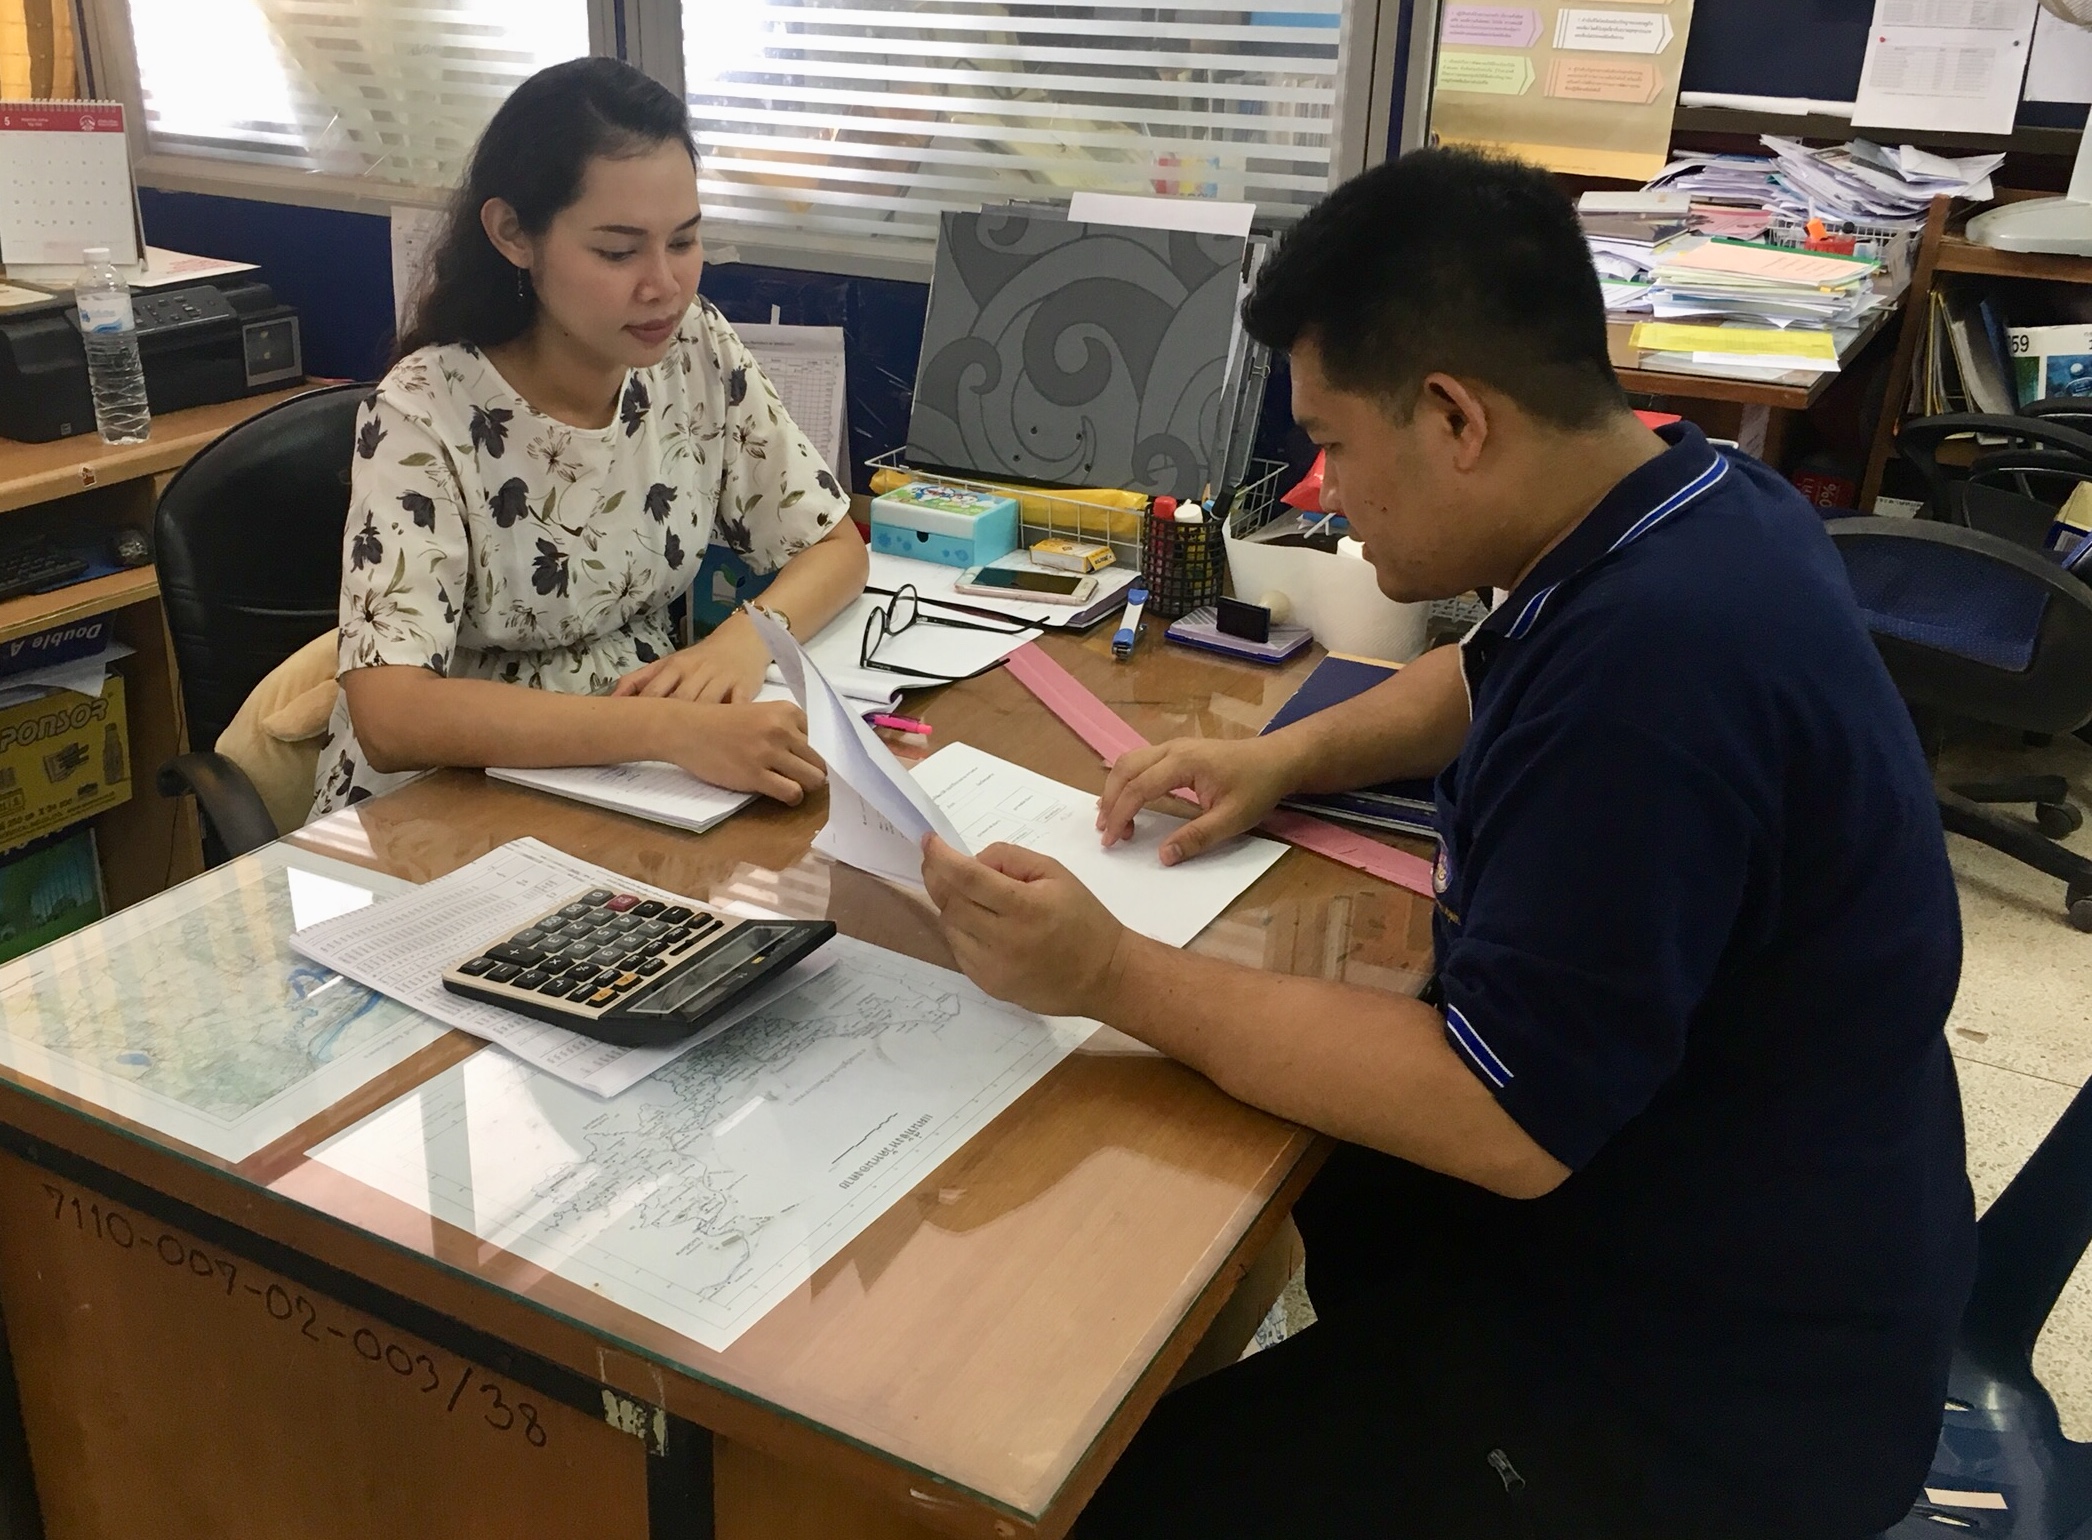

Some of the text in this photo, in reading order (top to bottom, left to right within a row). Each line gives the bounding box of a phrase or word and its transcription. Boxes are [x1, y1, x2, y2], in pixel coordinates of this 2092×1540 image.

[3, 116, 11, 127] 5
[2007, 334, 2030, 354] 59
[10, 623, 102, 657] Double A
[42, 1183, 547, 1448] 7110-007-02-003/38
